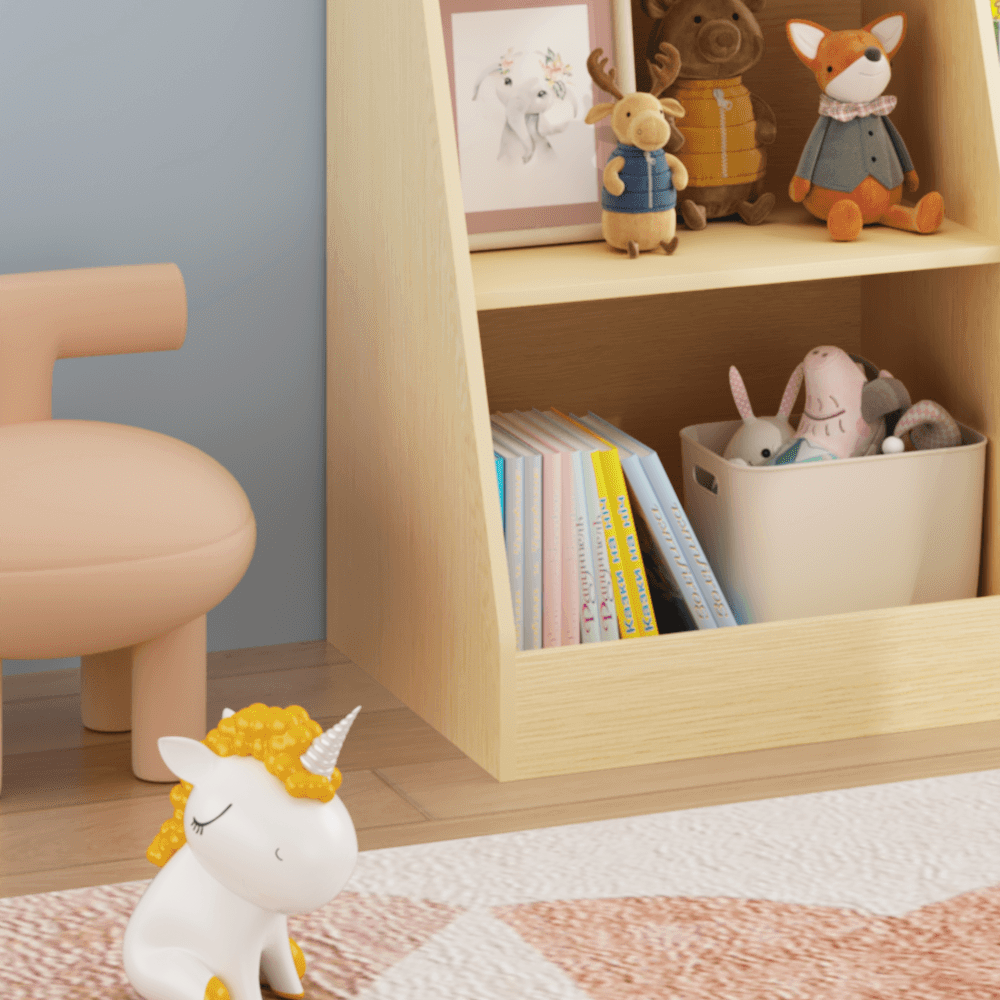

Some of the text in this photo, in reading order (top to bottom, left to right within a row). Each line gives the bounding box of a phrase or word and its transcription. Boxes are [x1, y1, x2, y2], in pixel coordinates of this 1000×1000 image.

[608, 535, 620, 564] на
[625, 533, 638, 562] на
[614, 569, 636, 635] Казки
[633, 567, 655, 633] Казки
